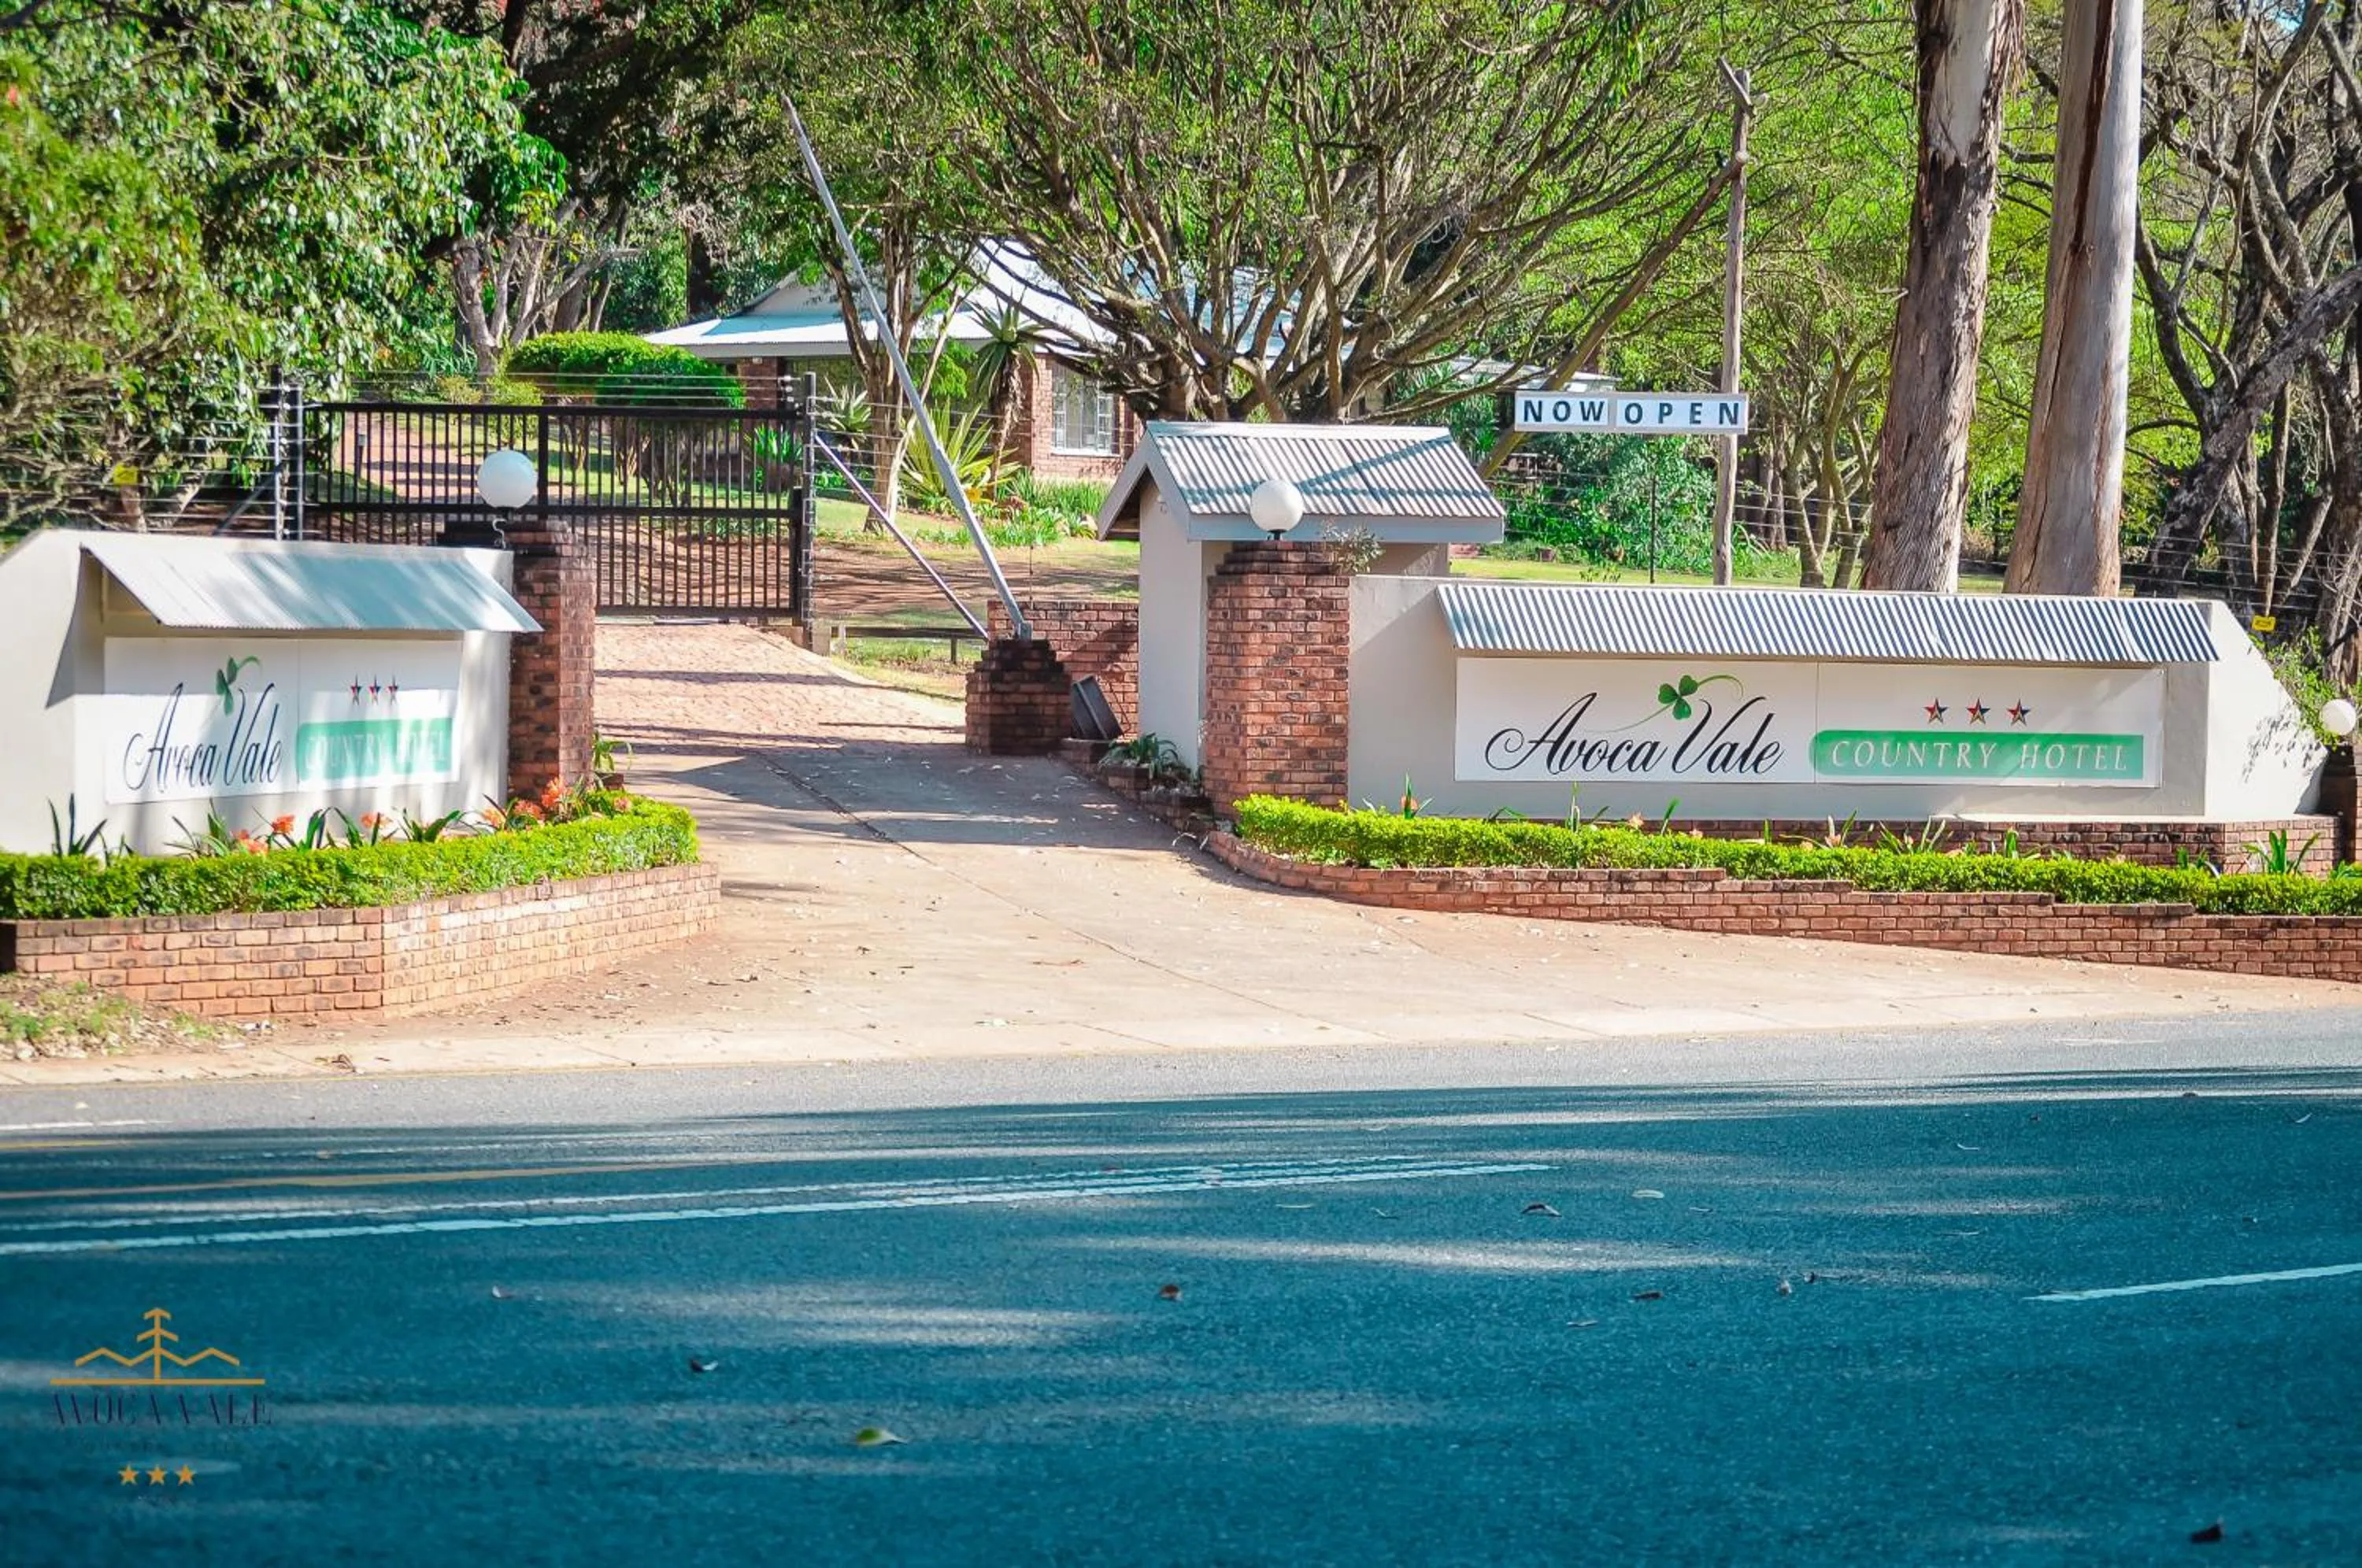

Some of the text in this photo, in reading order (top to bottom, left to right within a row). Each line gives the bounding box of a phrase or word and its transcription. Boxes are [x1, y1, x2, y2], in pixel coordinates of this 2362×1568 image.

[1523, 399, 1739, 425] NOW OPEN
[124, 682, 283, 793] Avoca Vale
[1485, 692, 1784, 775] Avoca Vale
[1831, 740, 2127, 771] COUNTRY HOTEL
